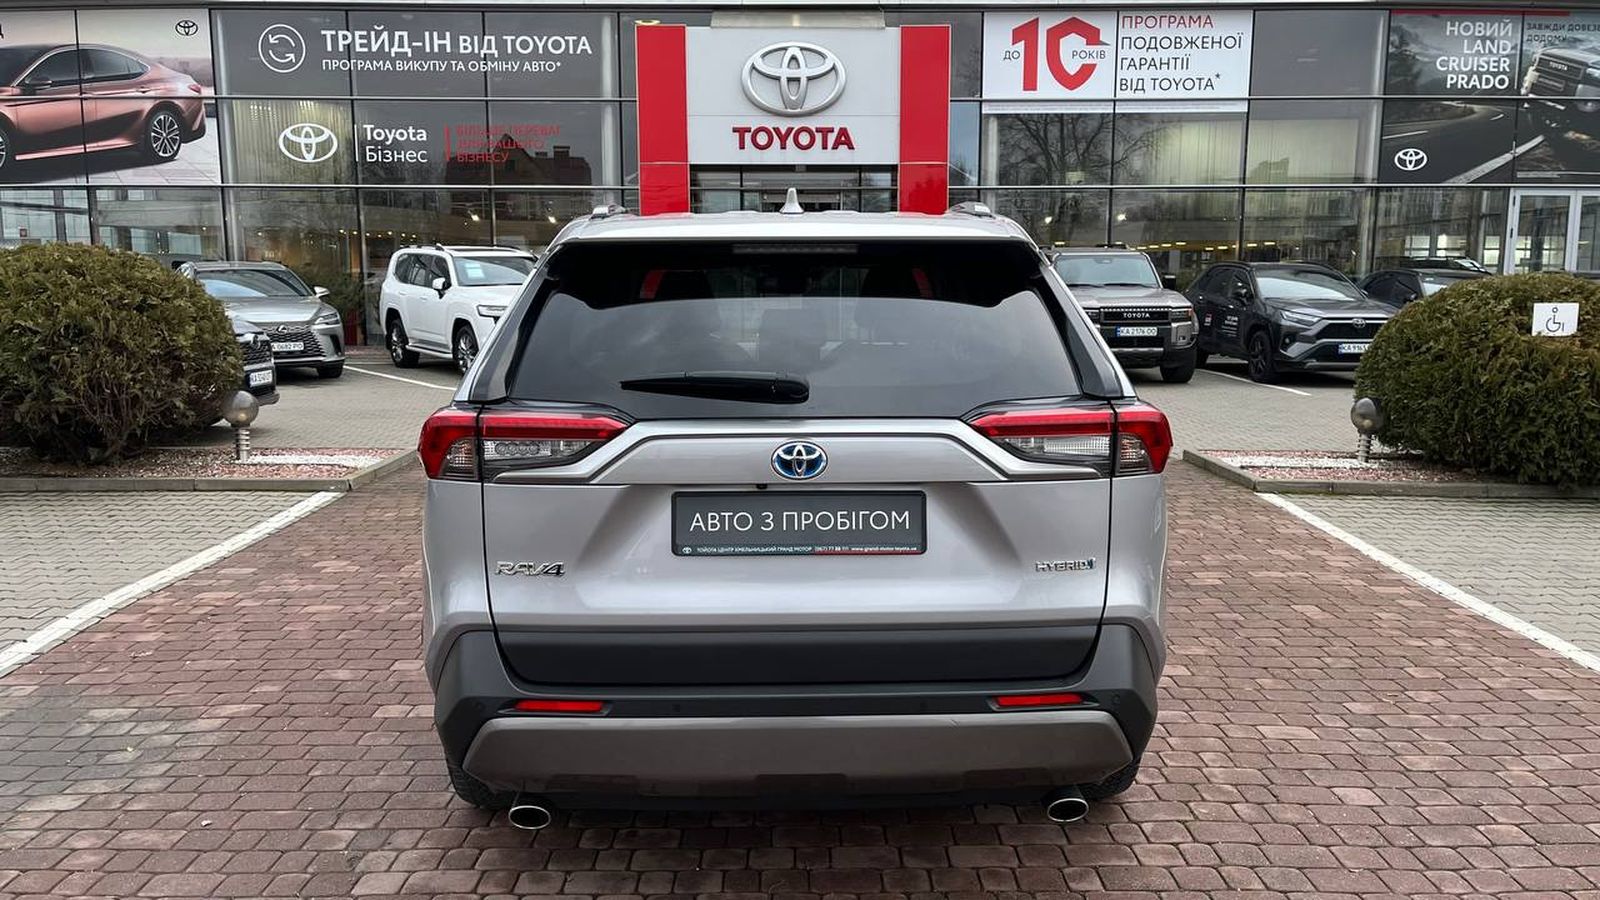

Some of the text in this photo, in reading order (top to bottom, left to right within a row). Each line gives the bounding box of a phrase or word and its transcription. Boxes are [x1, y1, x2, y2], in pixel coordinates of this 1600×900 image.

[1122, 15, 1214, 29] ПРОГРАМА
[1446, 19, 1513, 36] НОВИЙ
[1526, 22, 1566, 32] ЗАВЖДИ
[321, 25, 592, 58] ТРЕЙД-ІН ВІД TOYOTA
[1121, 32, 1244, 51] ПОДОВЖЕНОЇ
[1464, 40, 1511, 54] LAND
[1003, 16, 1106, 92] ДО 10 РОКІВ
[1120, 53, 1190, 71] ГАРАНТІЇ
[322, 60, 392, 71] ПРОГРАМА
[397, 61, 448, 71] ВИКУПУ
[450, 61, 465, 71] ТА
[468, 61, 520, 72] ОБМІНУ
[1436, 56, 1510, 72] CRUISER
[1120, 78, 1145, 92] ВІД
[1446, 75, 1509, 89] PRADO
[363, 125, 427, 145] Toyota
[732, 126, 855, 150] TOYOTA
[366, 145, 428, 163] Бізнес
[456, 152, 510, 162] БІЗНЕСУ
[690, 513, 752, 531] АВТО
[783, 511, 910, 530] ПРОБІГОМ
[496, 561, 565, 576] RAV4
[1035, 560, 1087, 572] HYBRID
